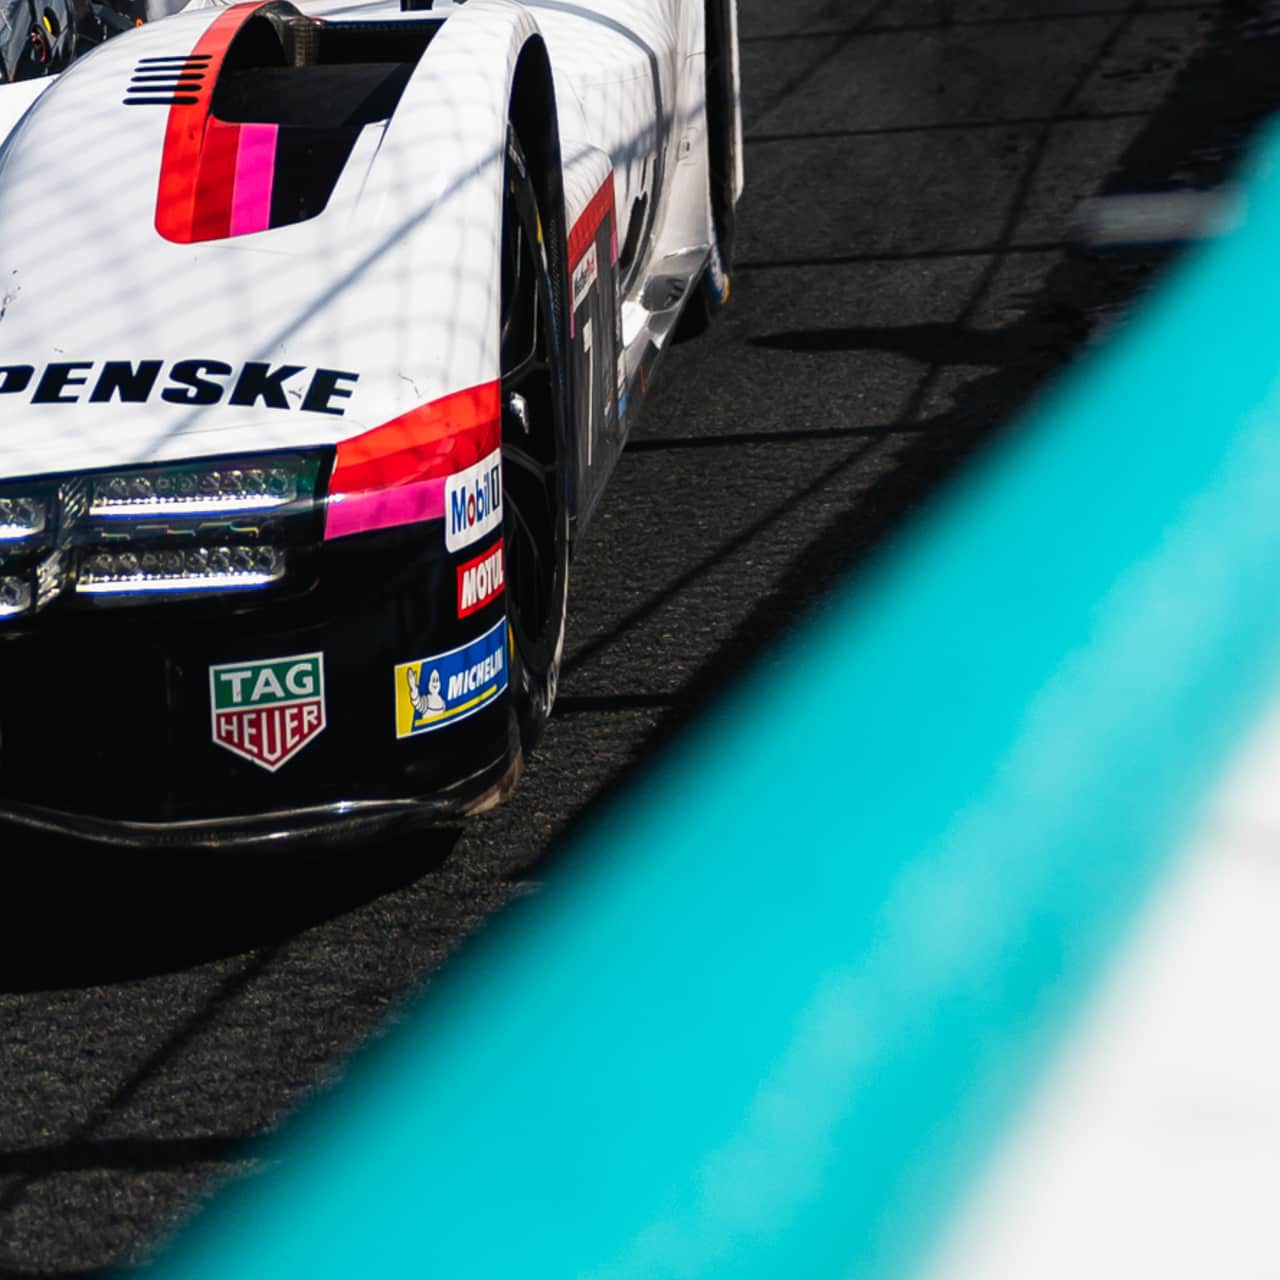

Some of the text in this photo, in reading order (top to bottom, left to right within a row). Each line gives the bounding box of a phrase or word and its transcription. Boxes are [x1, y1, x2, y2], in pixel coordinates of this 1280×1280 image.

[451, 471, 490, 535] Mobil
[461, 548, 504, 610] MOTUL
[220, 662, 315, 704] TAG
[447, 645, 504, 701] MICHELIN
[220, 704, 319, 762] HEUER
